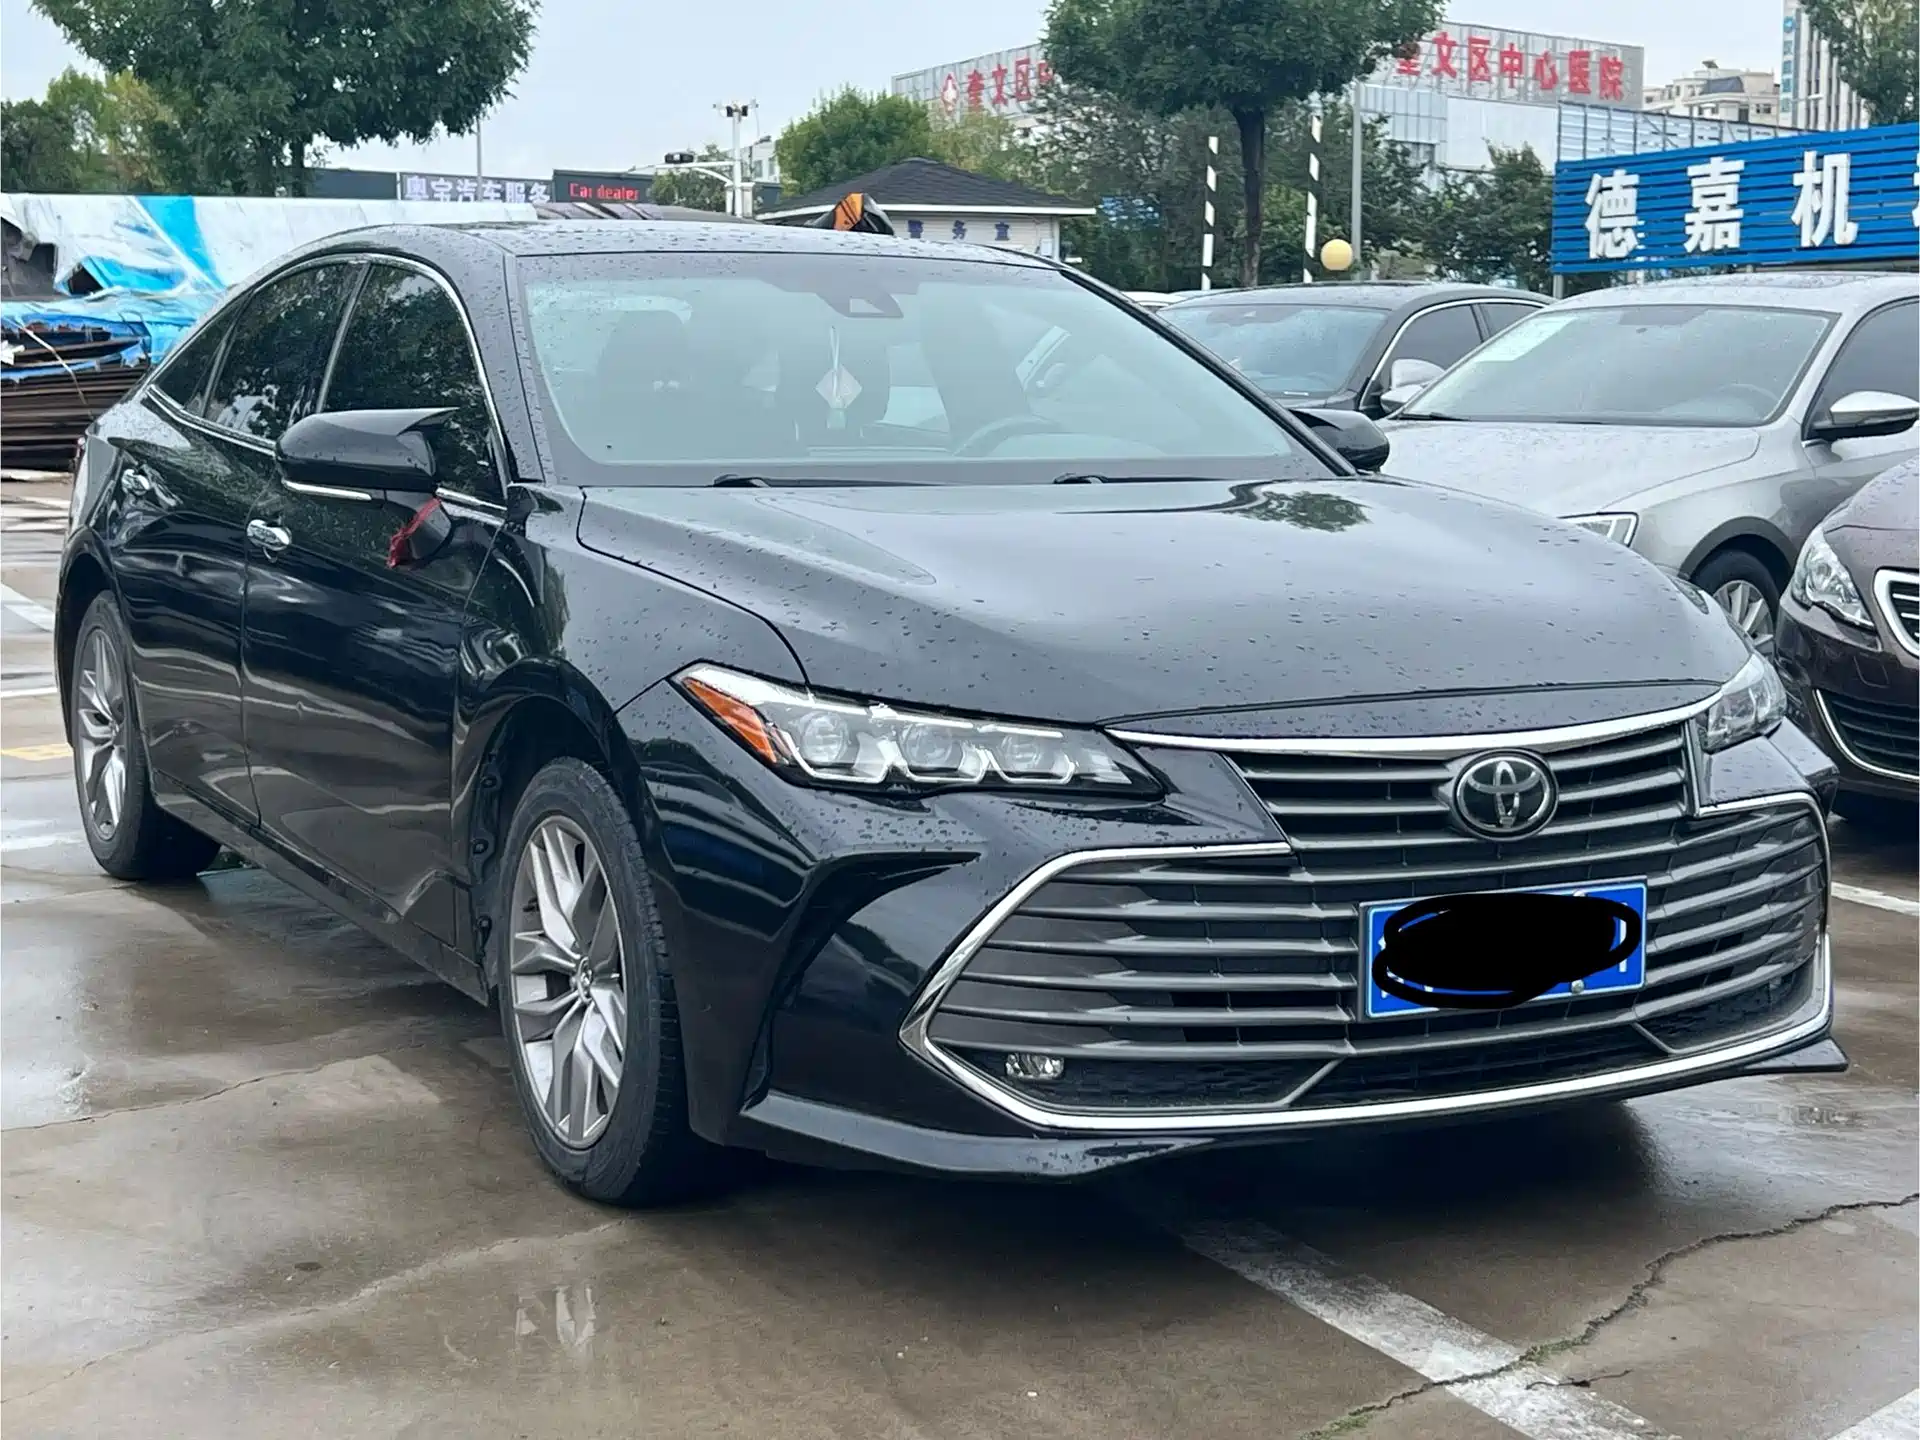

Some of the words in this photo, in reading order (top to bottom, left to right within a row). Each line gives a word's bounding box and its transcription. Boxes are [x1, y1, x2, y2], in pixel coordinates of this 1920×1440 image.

[596, 184, 640, 201] dealer
[1584, 150, 1919, 260] 德嘉机
[907, 219, 1011, 241] 警务室
